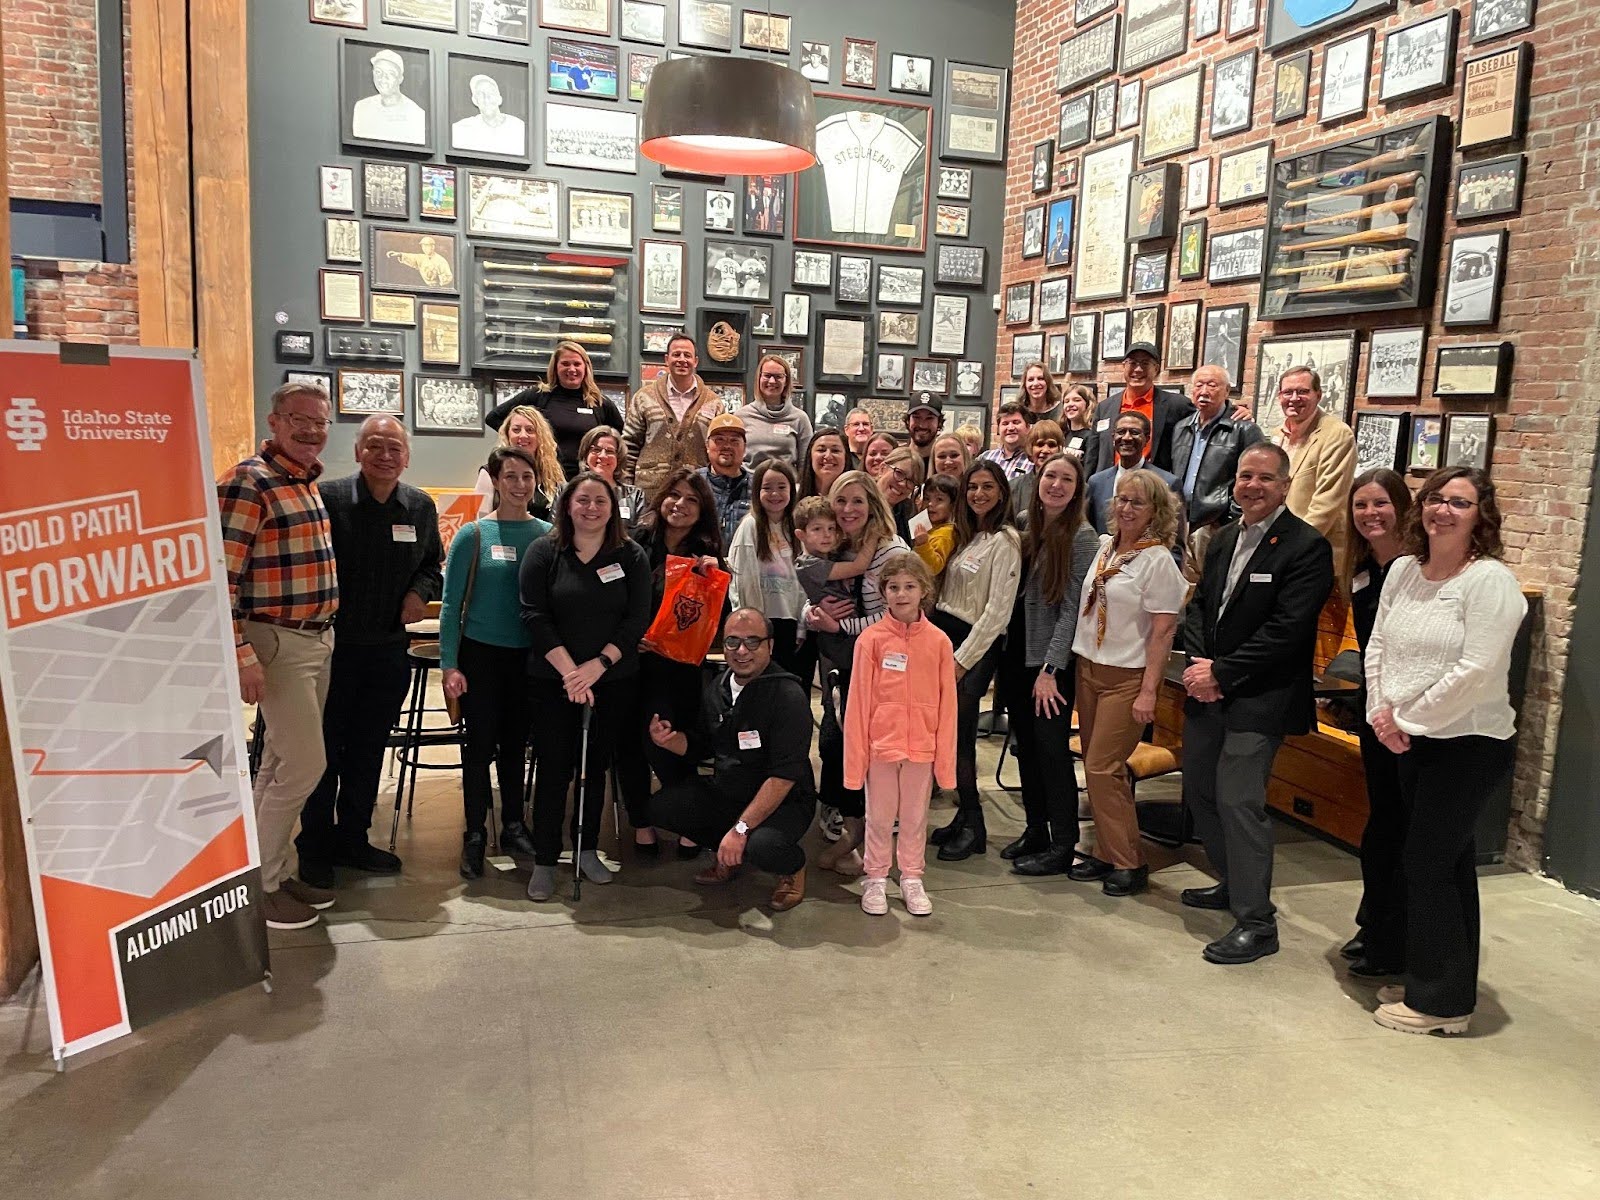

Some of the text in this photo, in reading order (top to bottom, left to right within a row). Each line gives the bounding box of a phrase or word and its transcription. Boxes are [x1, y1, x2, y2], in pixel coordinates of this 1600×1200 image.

[1468, 53, 1516, 76] BASEBALL
[834, 147, 895, 172] STEELHEADS
[723, 264, 734, 275] 30
[62, 409, 172, 426] Idaho State
[64, 426, 169, 443] University
[1, 503, 132, 556] BOLD PATH
[5, 532, 206, 620] FORWARD
[126, 884, 250, 963] ALUMNI TOUR
